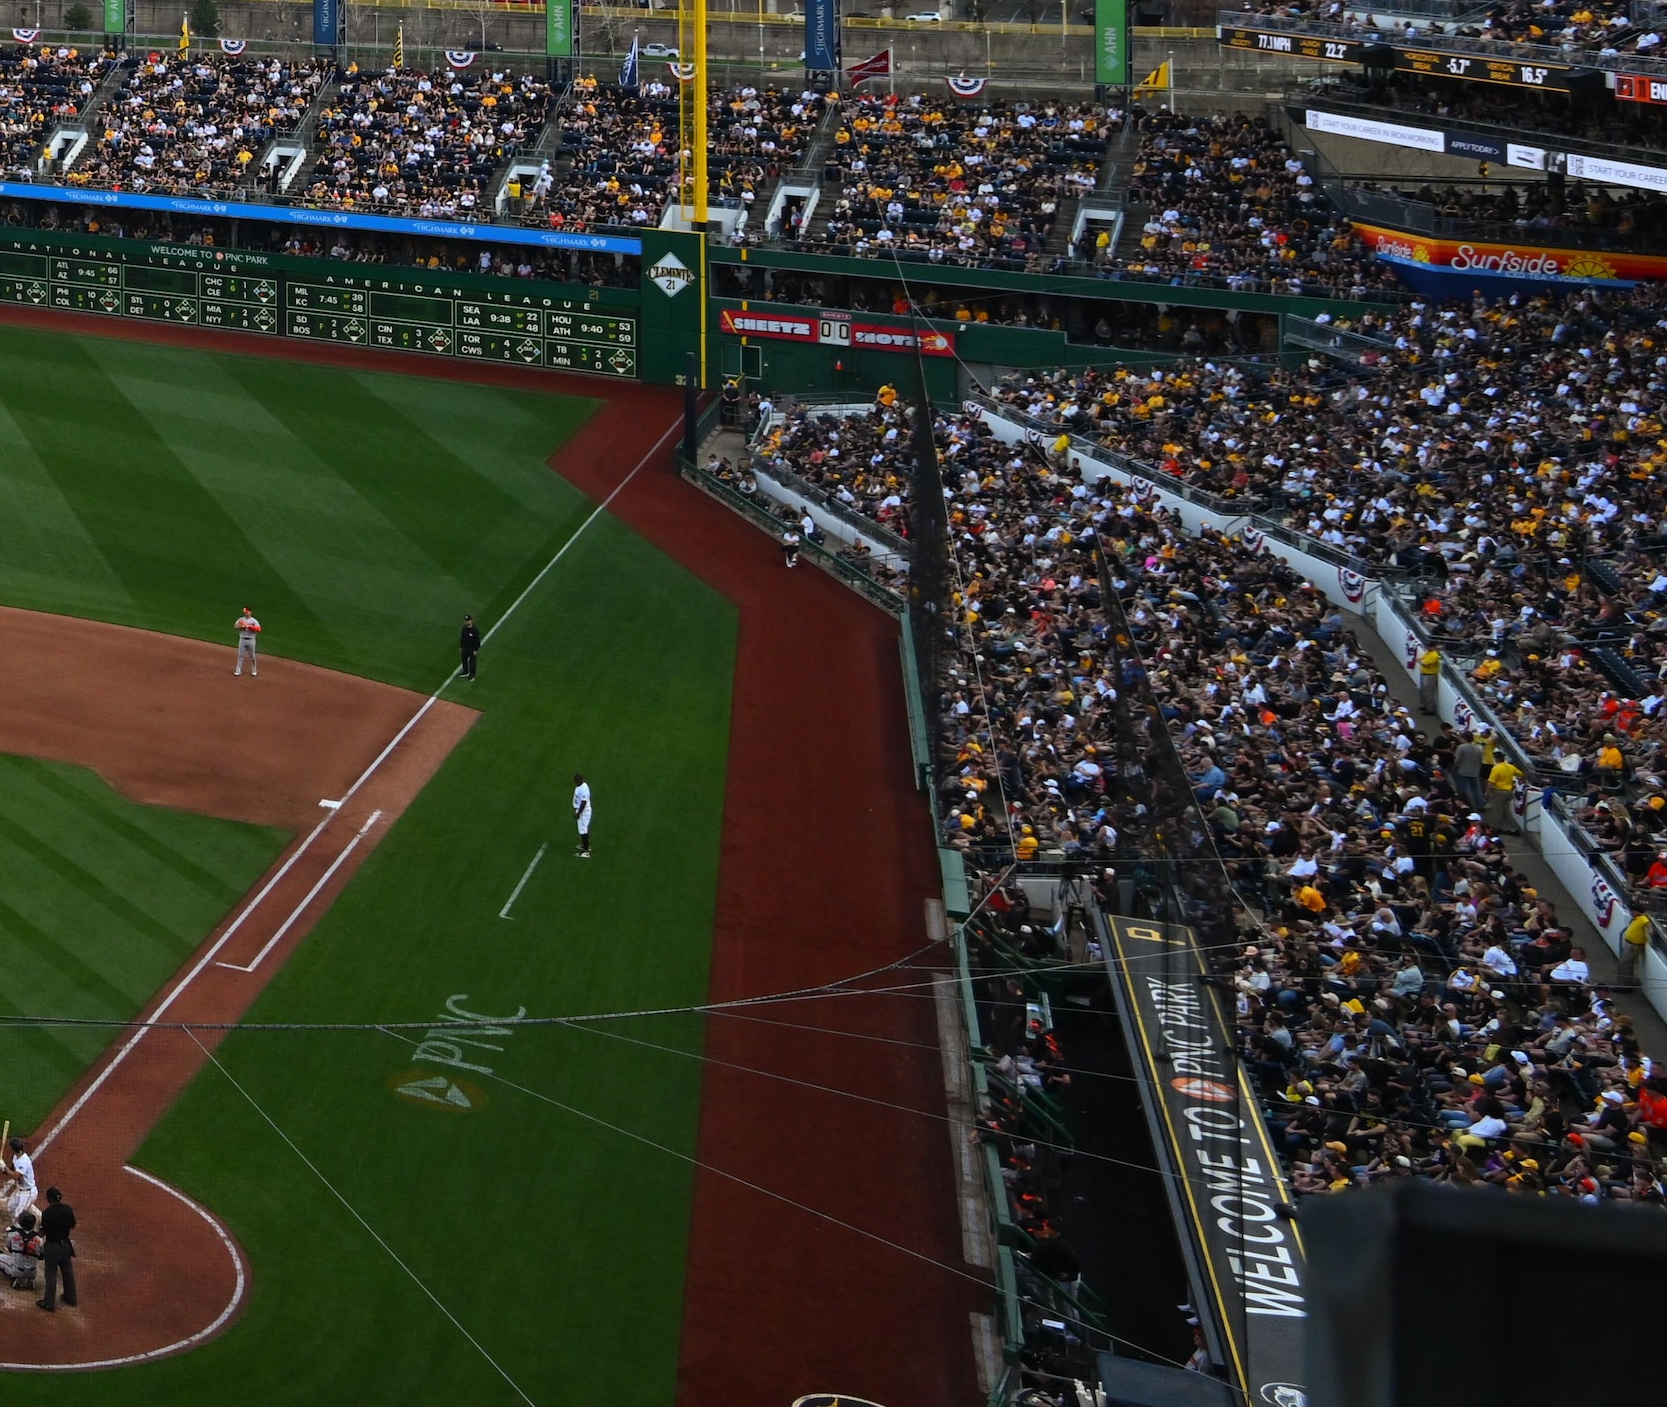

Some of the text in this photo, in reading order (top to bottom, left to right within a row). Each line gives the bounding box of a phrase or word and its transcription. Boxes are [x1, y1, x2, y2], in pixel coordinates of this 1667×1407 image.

[553, 4, 566, 31] AHN
[1104, 27, 1117, 54] AHN
[151, 245, 269, 266] WELCOME TO PNC PARK
[1451, 245, 1558, 274] Surfside
[647, 264, 693, 284] CLEMENTE
[665, 279, 675, 290] 21
[463, 305, 481, 315] SEA
[551, 315, 572, 325] HOU
[463, 316, 481, 326] LAA
[552, 326, 570, 336] ATH
[733, 318, 811, 336] SHEETZ
[412, 994, 526, 1074] PNC
[1145, 976, 1309, 1317] WELCOME TO PNC PARK
